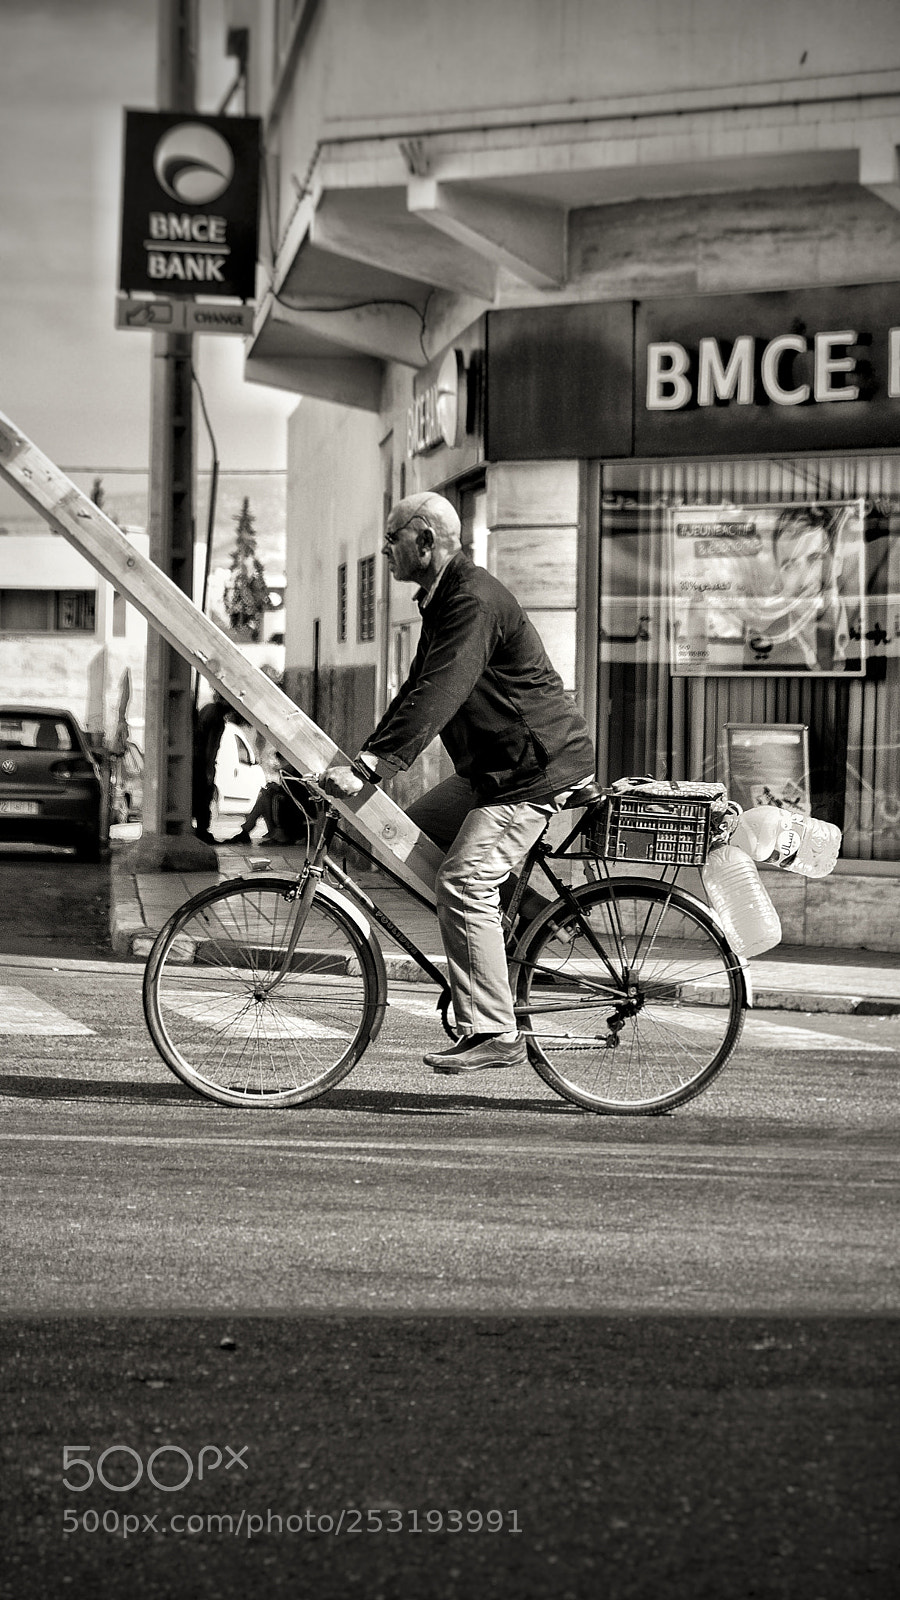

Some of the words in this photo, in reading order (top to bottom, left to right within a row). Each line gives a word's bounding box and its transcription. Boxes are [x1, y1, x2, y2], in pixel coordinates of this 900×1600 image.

[149, 212, 227, 243] BMCE
[148, 252, 226, 282] BANK
[194, 311, 245, 326] CHANGE
[646, 330, 859, 411] BMCE
